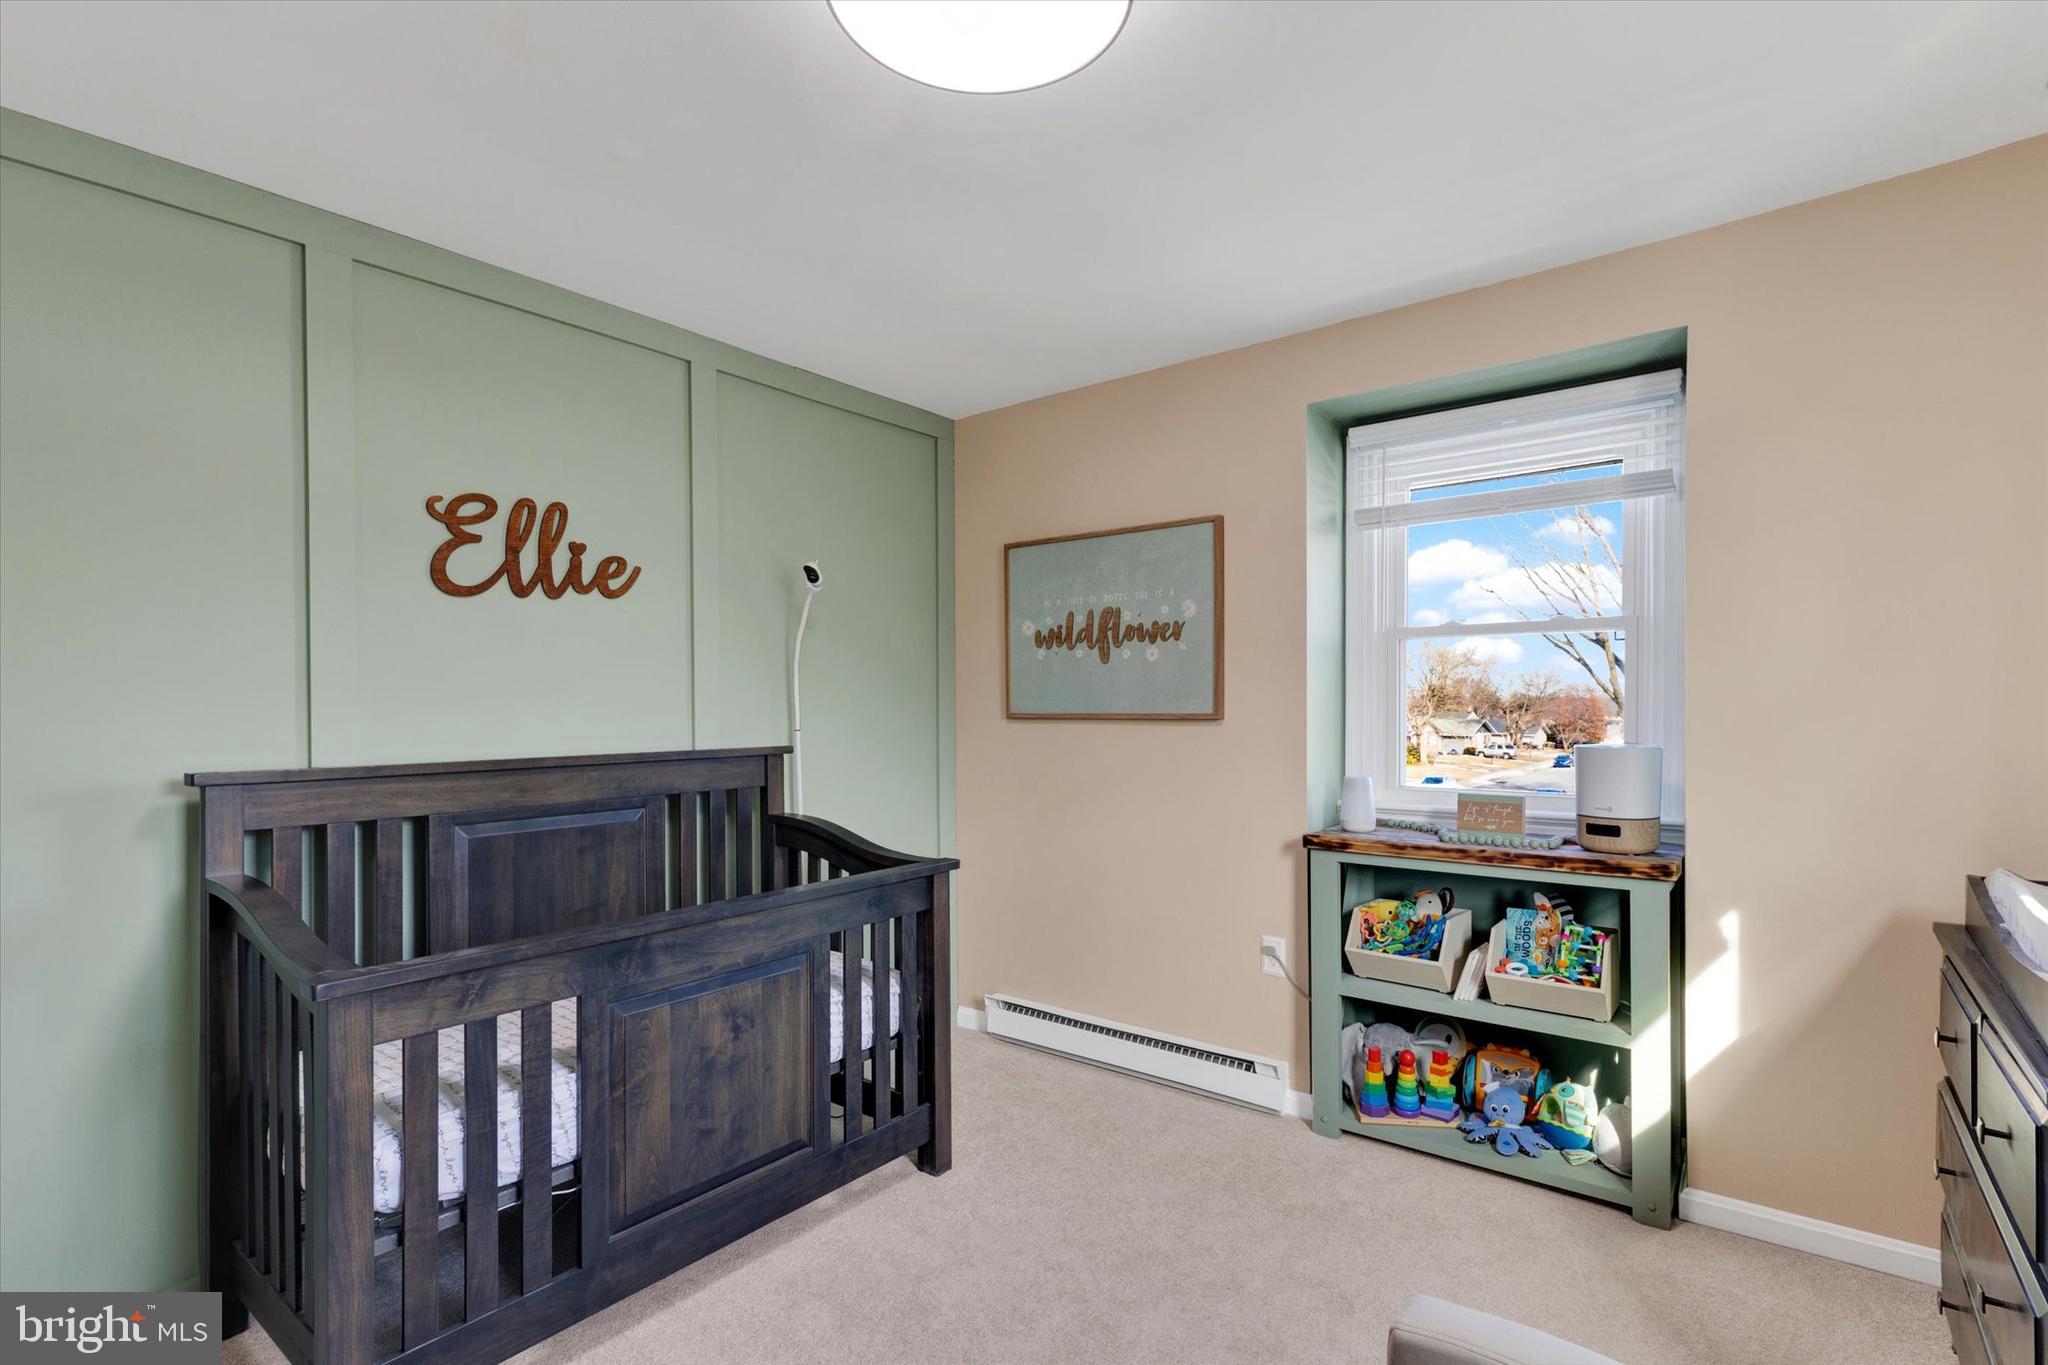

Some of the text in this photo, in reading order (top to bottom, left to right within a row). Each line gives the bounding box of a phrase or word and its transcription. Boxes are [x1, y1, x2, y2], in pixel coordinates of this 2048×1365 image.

[426, 492, 642, 600] Ellie
[1034, 606, 1186, 665] wildflower
[1522, 920, 1532, 957] WOODS
